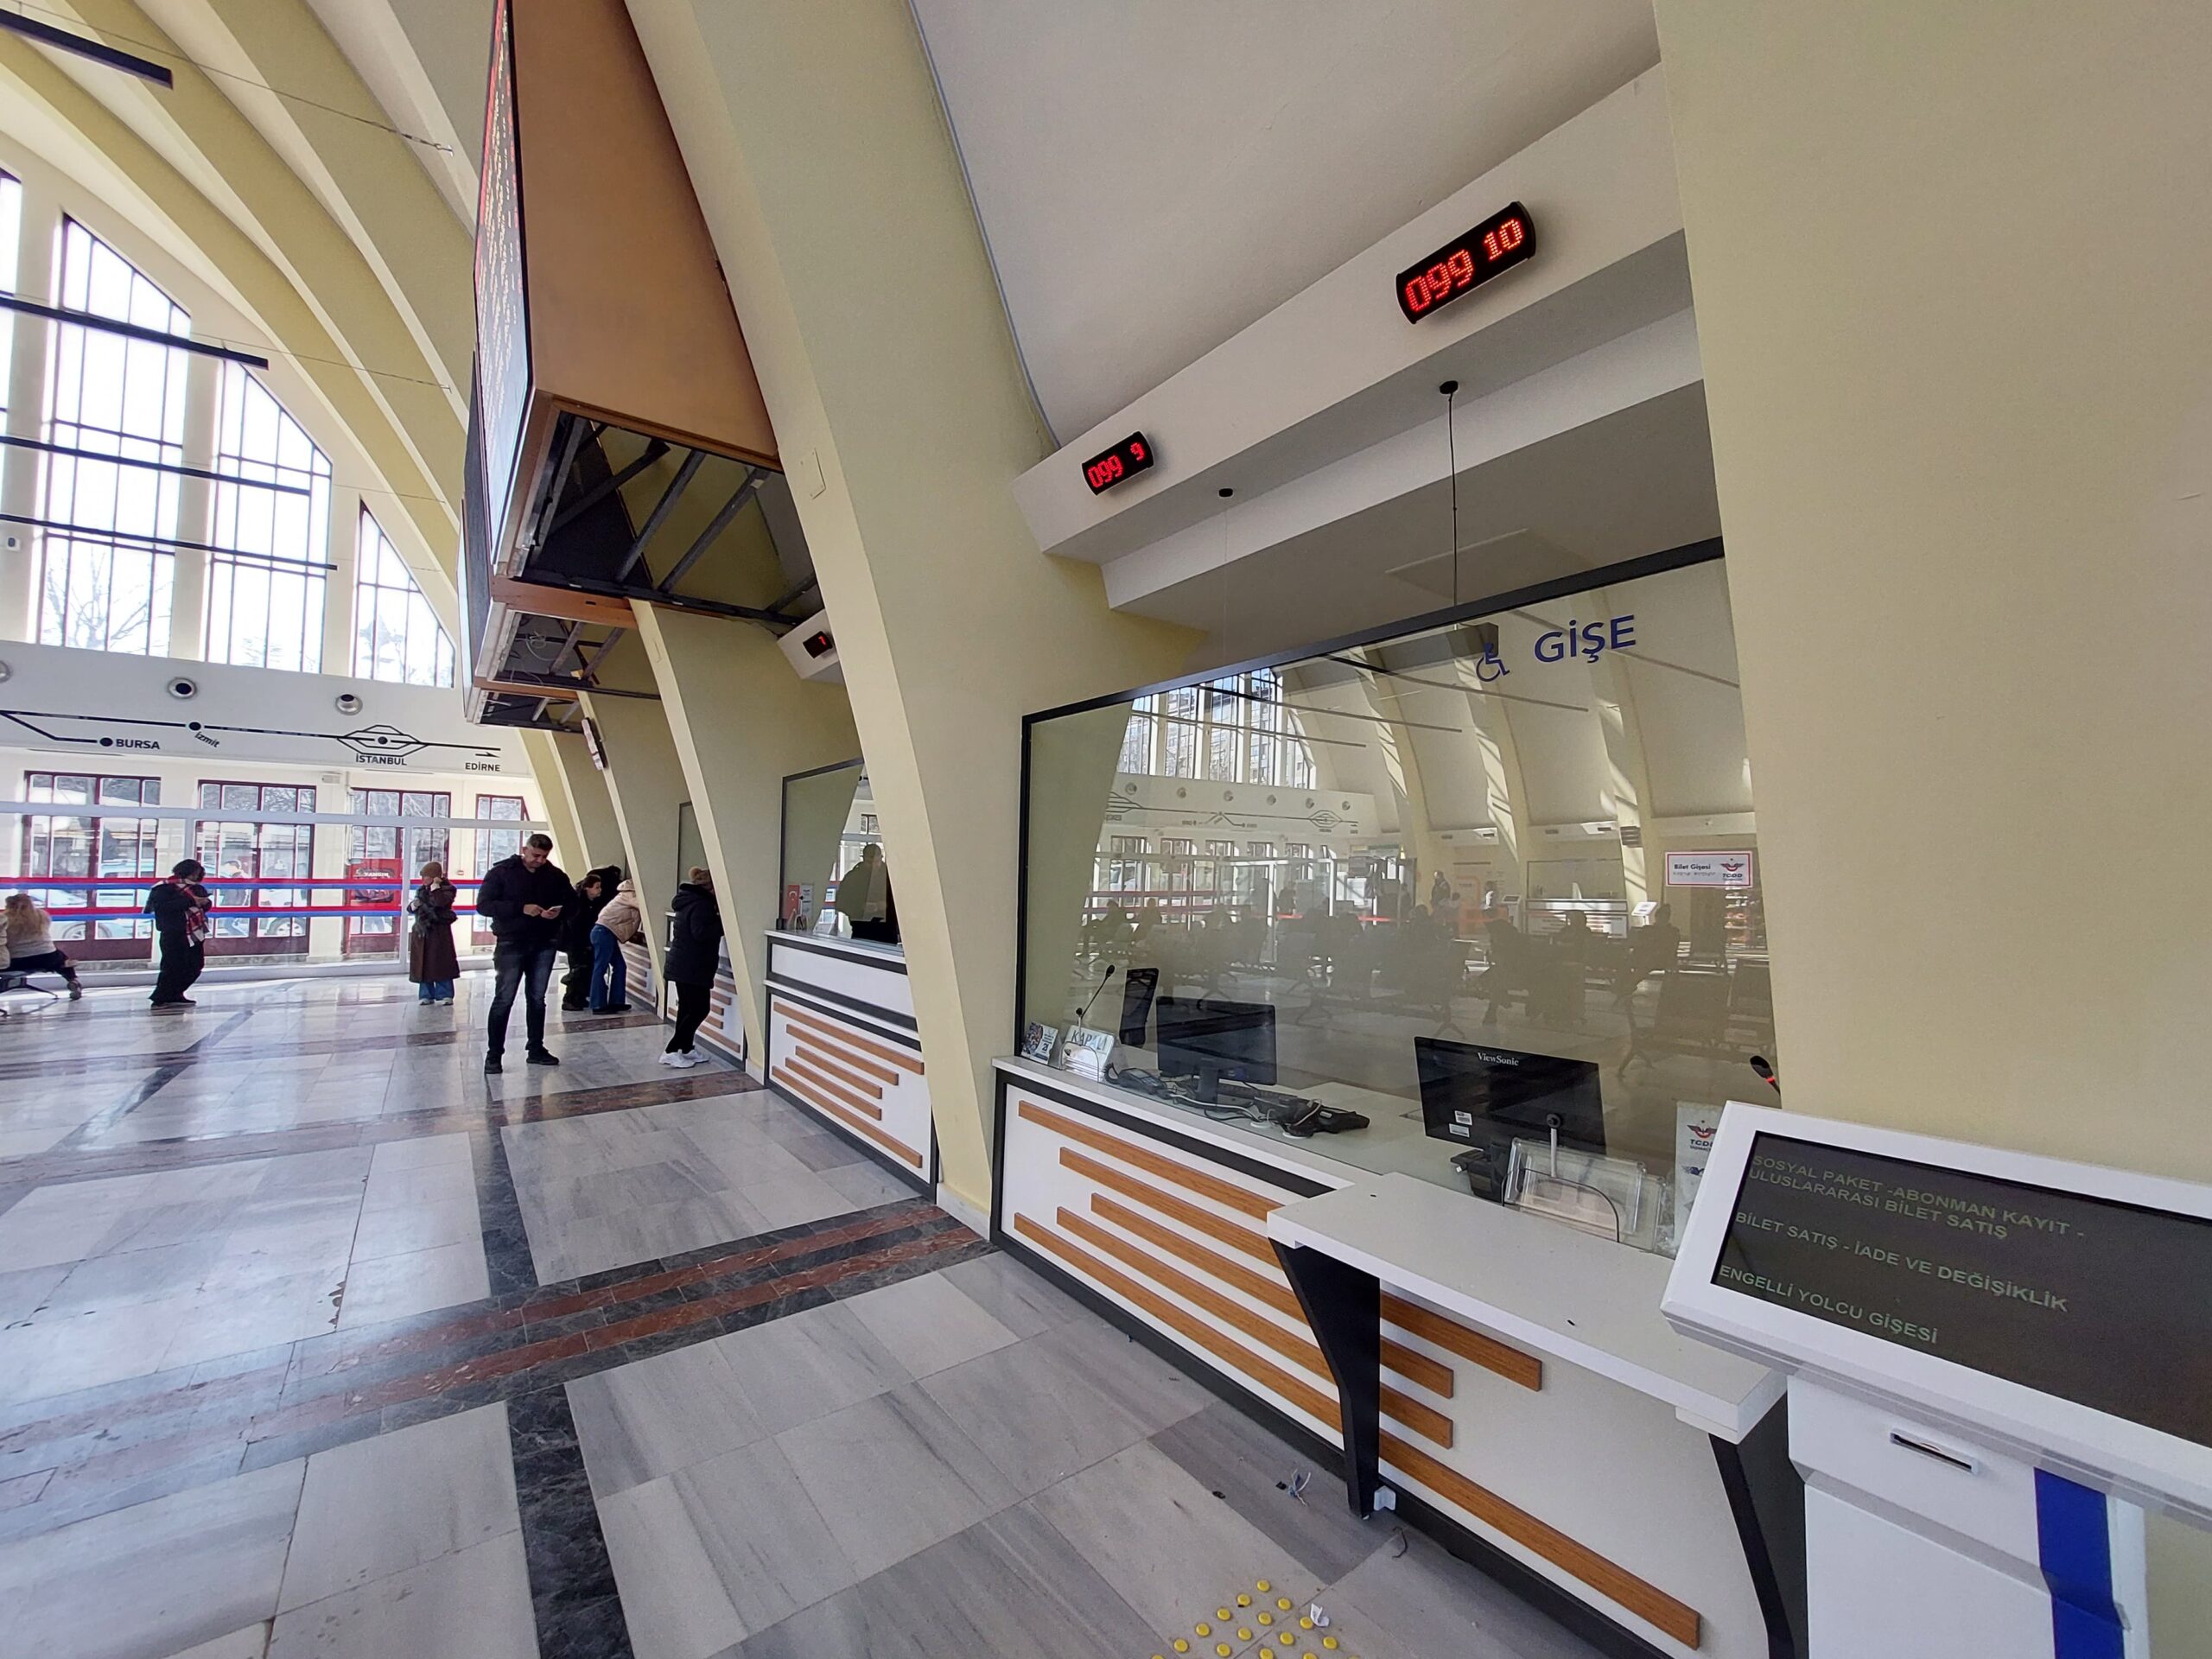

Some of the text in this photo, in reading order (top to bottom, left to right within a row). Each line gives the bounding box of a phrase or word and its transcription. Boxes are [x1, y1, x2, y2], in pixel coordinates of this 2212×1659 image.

[1405, 219, 1523, 312] 099 10
[1087, 442, 1145, 488] 099 9
[1535, 614, 1636, 664] GİŞE
[116, 739, 160, 750] BURSA
[355, 753, 407, 766] İSTANBUL
[465, 761, 501, 772] EDİRNE
[1477, 1052, 1519, 1066] ViewSonic
[1749, 1168, 2008, 1239] ULUSLARARASI BİLET SATIŞ
[1752, 1155, 1817, 1179] SOSYAL
[1822, 1170, 1883, 1192] PAKET
[2002, 1210, 2070, 1235] KAYIT
[1735, 1211, 1784, 1233] BİLET
[1787, 1225, 1839, 1250] SATIŞ
[1854, 1241, 1899, 1266] İADE
[1906, 1256, 1933, 1274] VE
[1937, 1265, 2069, 1313] DEĞİŞİKLİK
[1719, 1265, 1938, 1344] ENGELLİ YOLCU GİŞESİ
